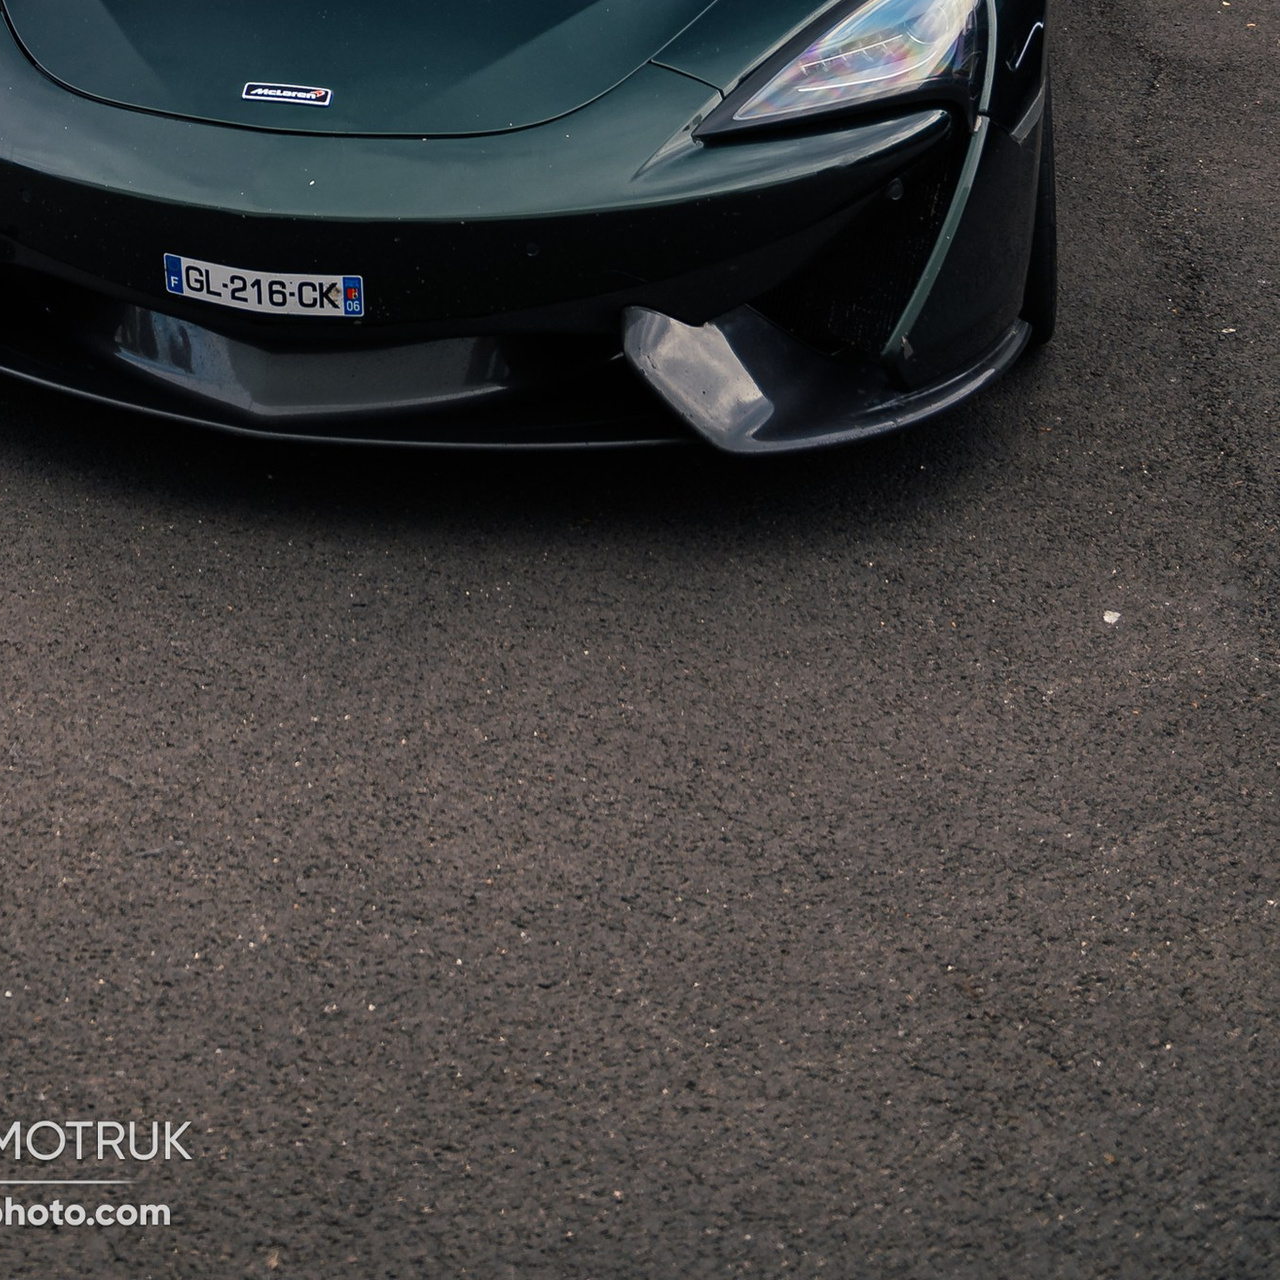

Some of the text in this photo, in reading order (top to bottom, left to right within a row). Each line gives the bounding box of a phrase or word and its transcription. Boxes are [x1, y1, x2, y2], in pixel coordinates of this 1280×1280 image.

[250, 88, 317, 100] McLaren
[170, 275, 179, 288] F
[184, 265, 341, 310] GL-216-CK
[346, 300, 361, 312] 06
